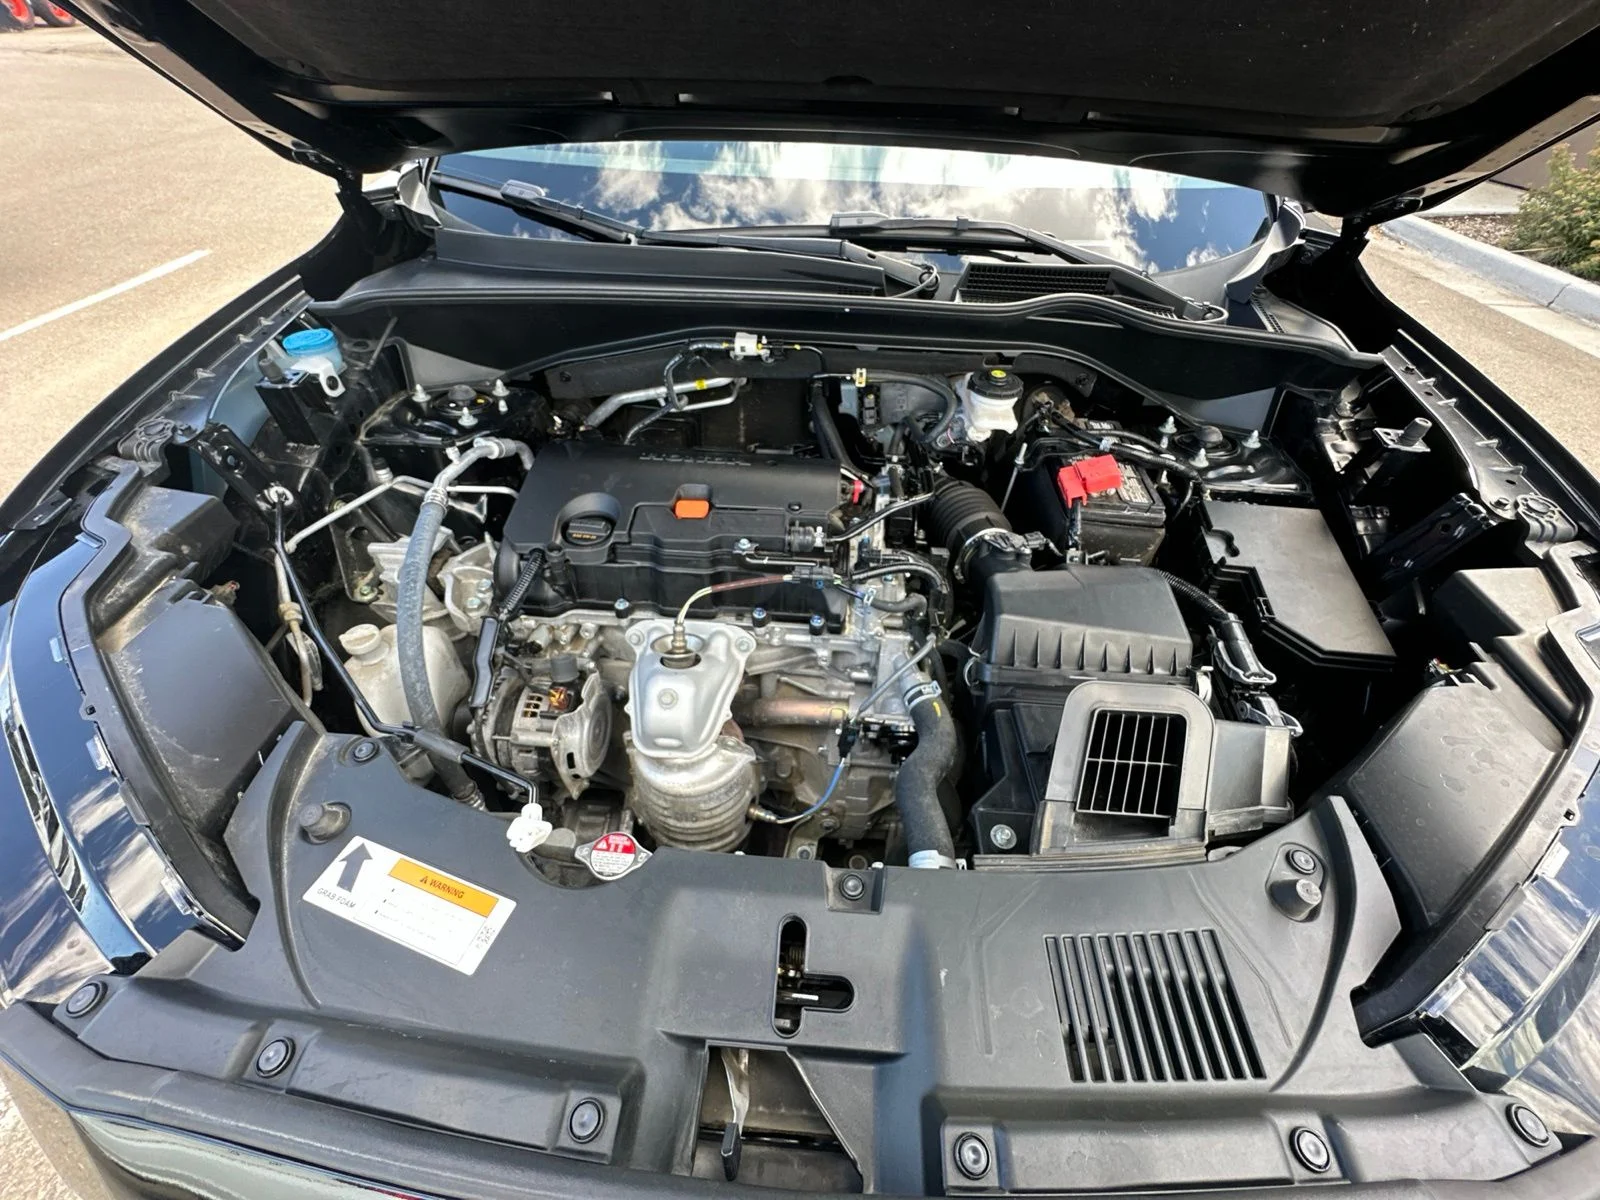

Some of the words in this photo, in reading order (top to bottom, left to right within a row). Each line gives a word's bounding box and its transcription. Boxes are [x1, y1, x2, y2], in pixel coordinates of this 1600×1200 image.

[317, 888, 337, 900] GRAB
[336, 896, 356, 908] FOAM
[430, 879, 465, 899] WARNING
